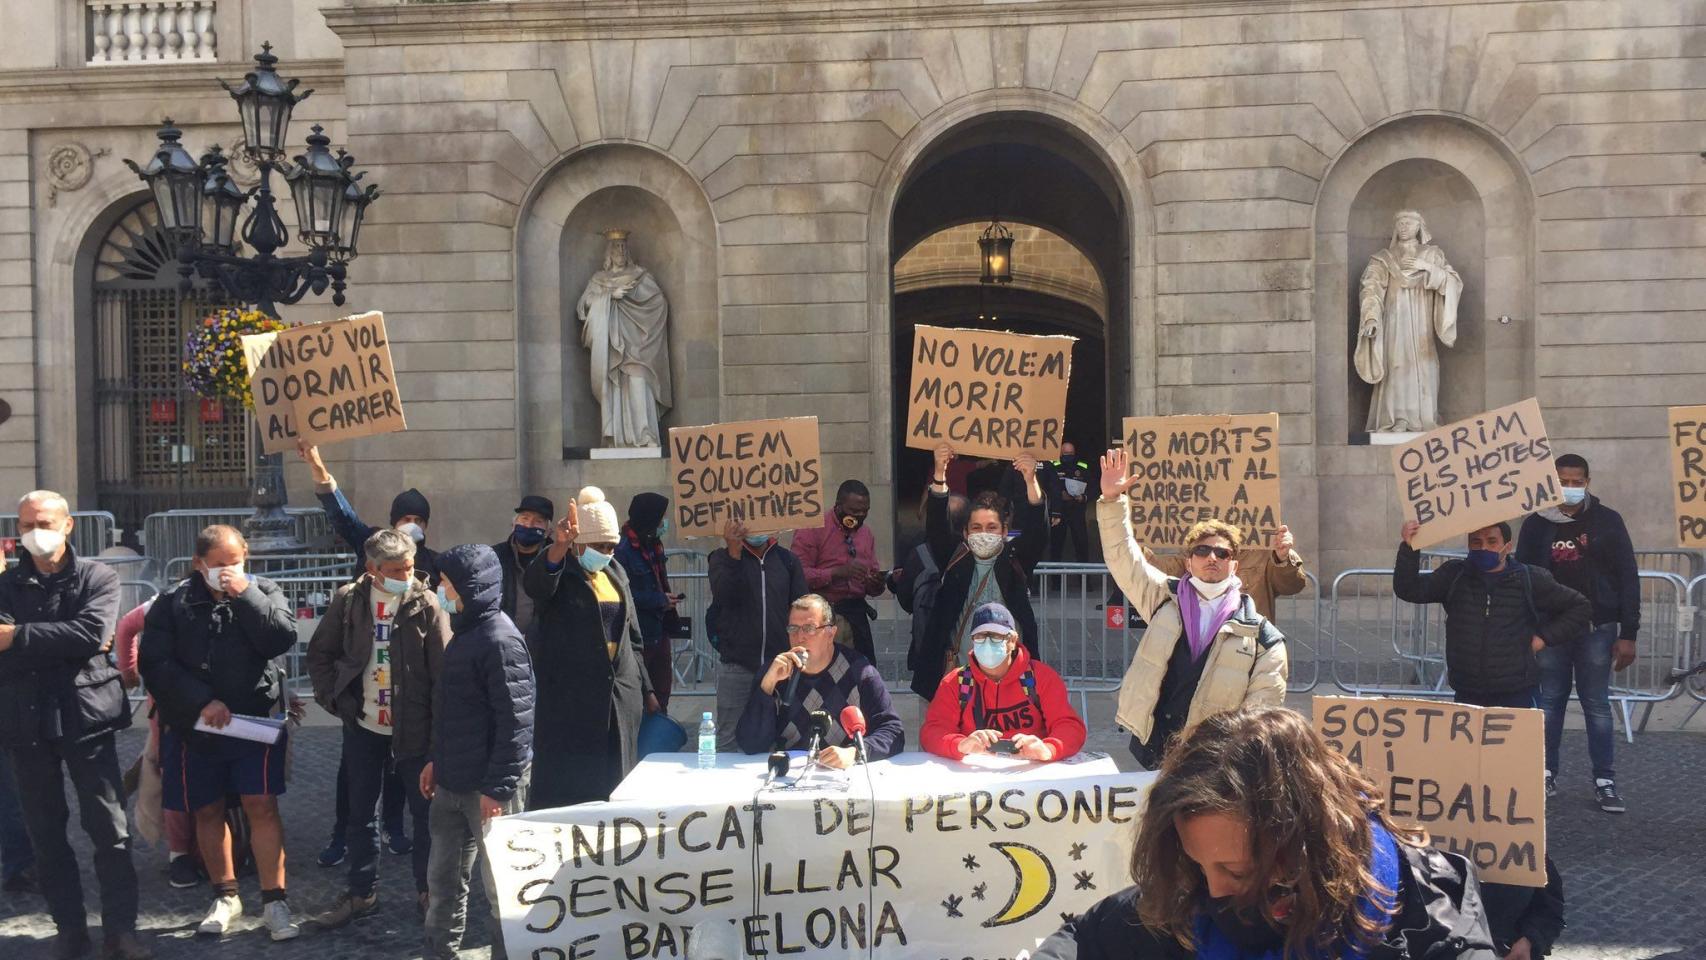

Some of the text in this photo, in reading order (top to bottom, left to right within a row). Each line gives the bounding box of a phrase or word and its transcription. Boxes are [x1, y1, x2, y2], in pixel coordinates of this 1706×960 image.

[344, 323, 386, 352] VOL
[918, 336, 1064, 379] NO VOLEM
[261, 353, 389, 406] DORMIR
[268, 389, 402, 440] AL CARRER
[913, 409, 1059, 449] AL CARRER
[675, 430, 793, 464] VOLEM
[1126, 426, 1273, 458] 18 MORTS
[1243, 457, 1277, 480] AL
[1408, 437, 1551, 501] ELS HOTELS
[1128, 482, 1248, 505] CARRER A
[1521, 475, 1558, 511] JA!
[1132, 503, 1276, 528] BARCELONA
[983, 701, 1034, 732] VANS
[1321, 704, 1516, 746] SOSTRE
[813, 797, 870, 836] DE
[1389, 776, 1534, 826] EBALL
[517, 845, 902, 934] SENSE LLAR
[621, 900, 908, 960] BAELONA
